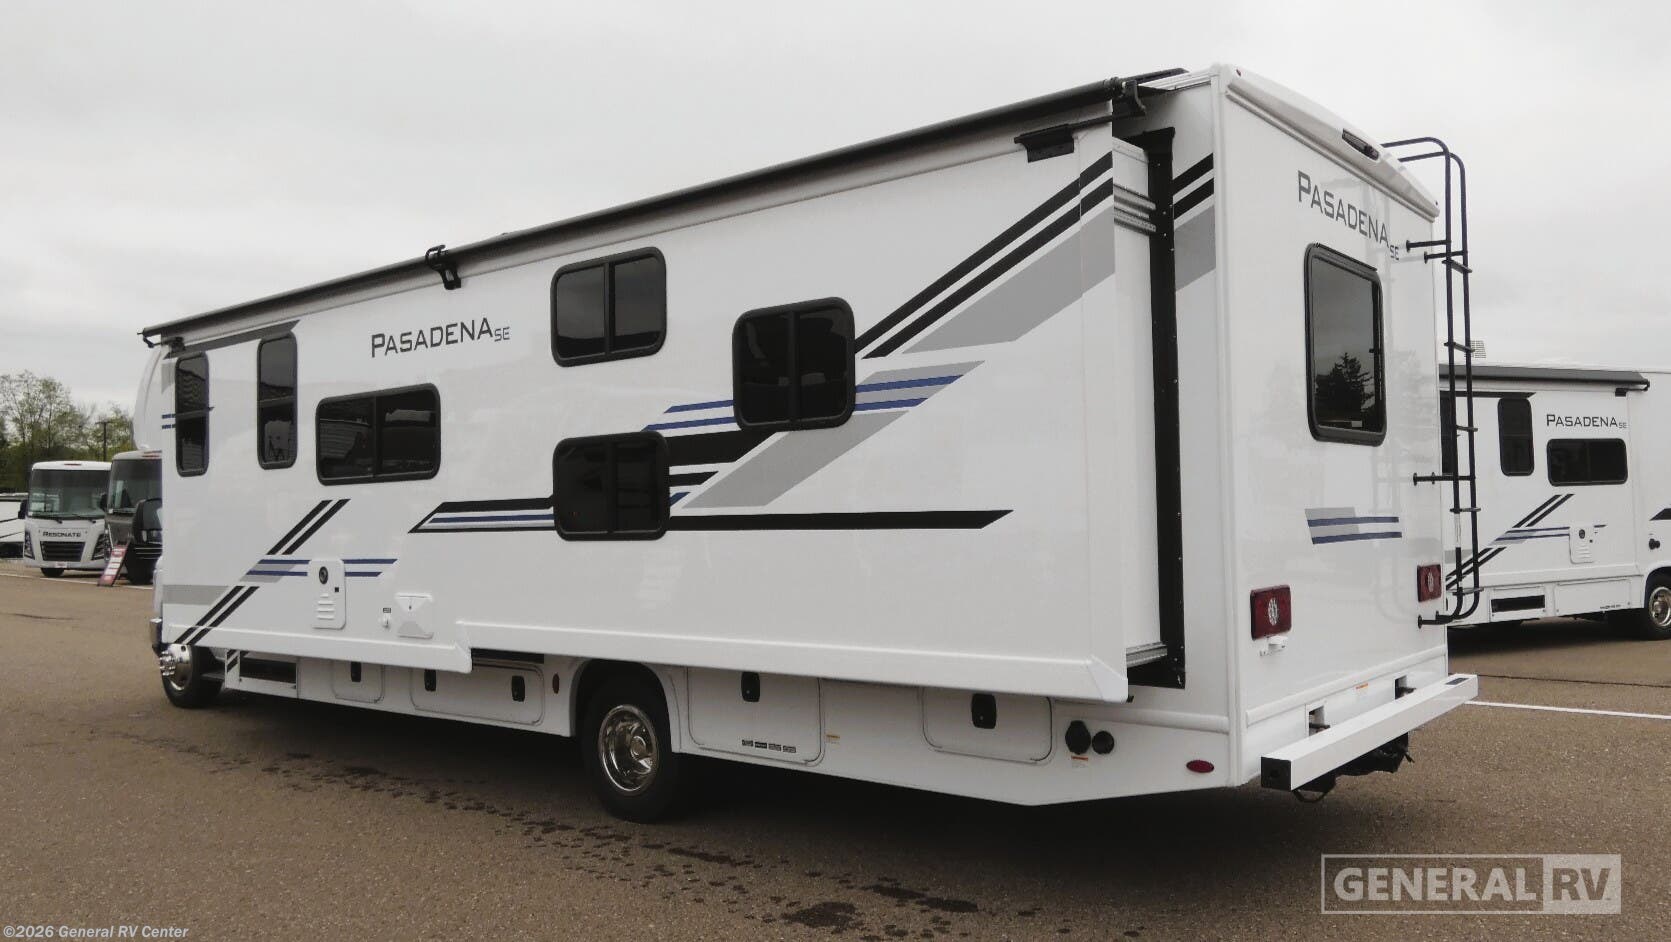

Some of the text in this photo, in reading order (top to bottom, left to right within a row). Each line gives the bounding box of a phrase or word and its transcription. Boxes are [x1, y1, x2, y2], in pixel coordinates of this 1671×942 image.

[1297, 169, 1390, 249] PASADENA
[371, 316, 511, 359] PASADENA SE
[1545, 413, 1618, 428] PASADENA
